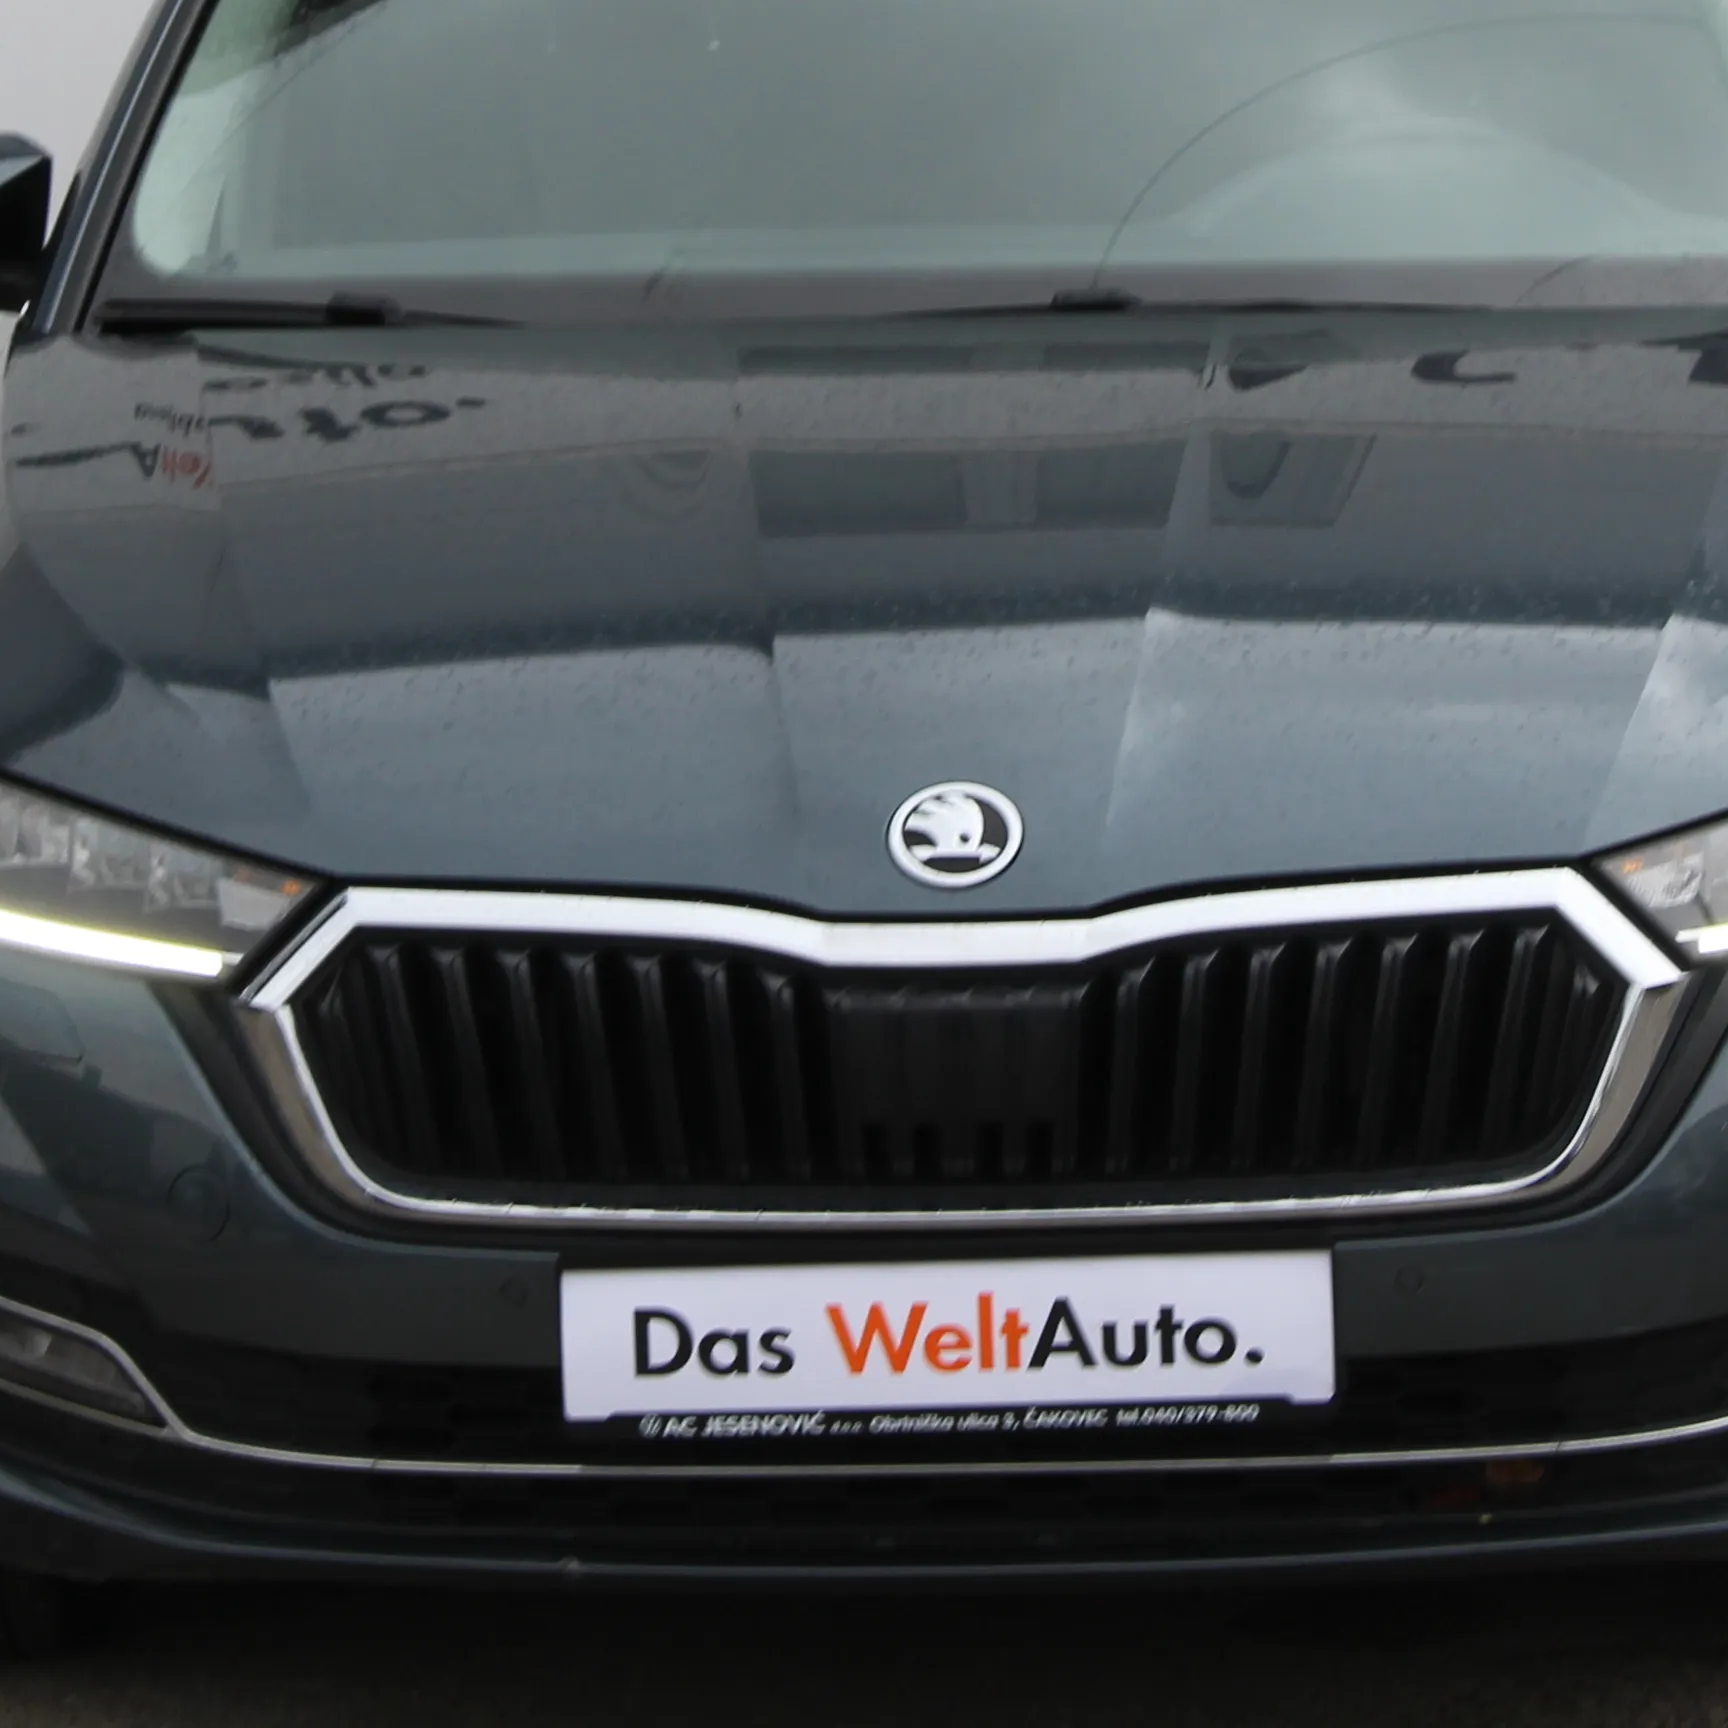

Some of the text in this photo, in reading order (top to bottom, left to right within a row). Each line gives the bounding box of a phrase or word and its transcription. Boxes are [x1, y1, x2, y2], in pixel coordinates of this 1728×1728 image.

[633, 1292, 1264, 1378] Das WeltAuto.
[701, 1408, 827, 1438] JESENOVIĆ
[957, 1411, 1000, 1433] ulica
[1023, 1404, 1110, 1430] ČAKOVEC
